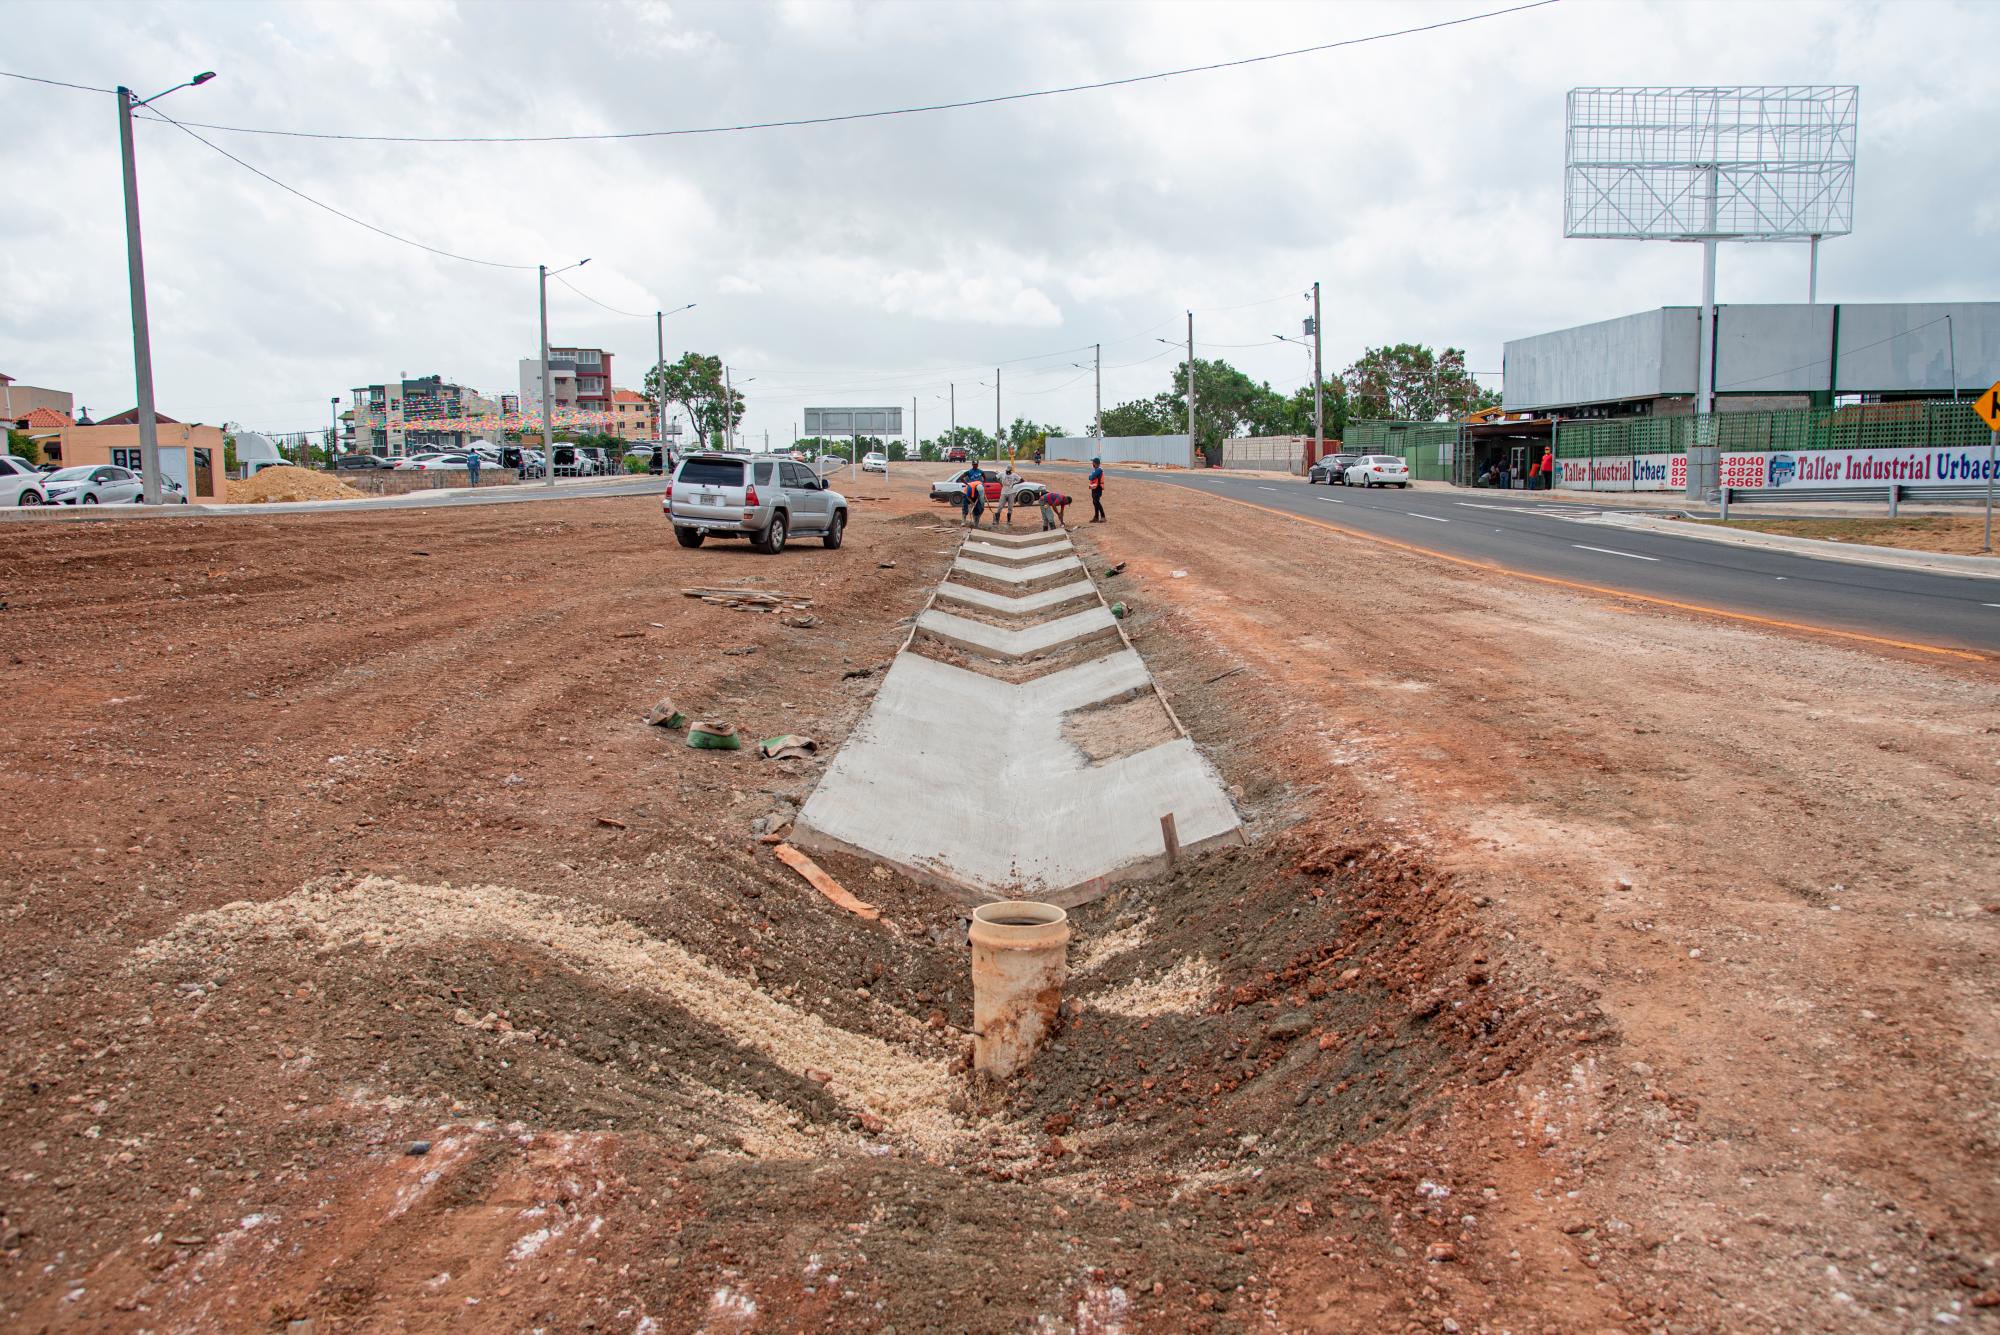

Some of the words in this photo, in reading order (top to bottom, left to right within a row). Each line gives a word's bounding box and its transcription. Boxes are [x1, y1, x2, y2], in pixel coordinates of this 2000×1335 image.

[1563, 463, 1586, 481] Taller
[1588, 460, 1631, 481] Industrial
[1633, 460, 1666, 480] Urbaez
[1798, 456, 1841, 480] Taller
[1845, 454, 1931, 480] Industrial
[1937, 453, 2000, 480] Urbaez
